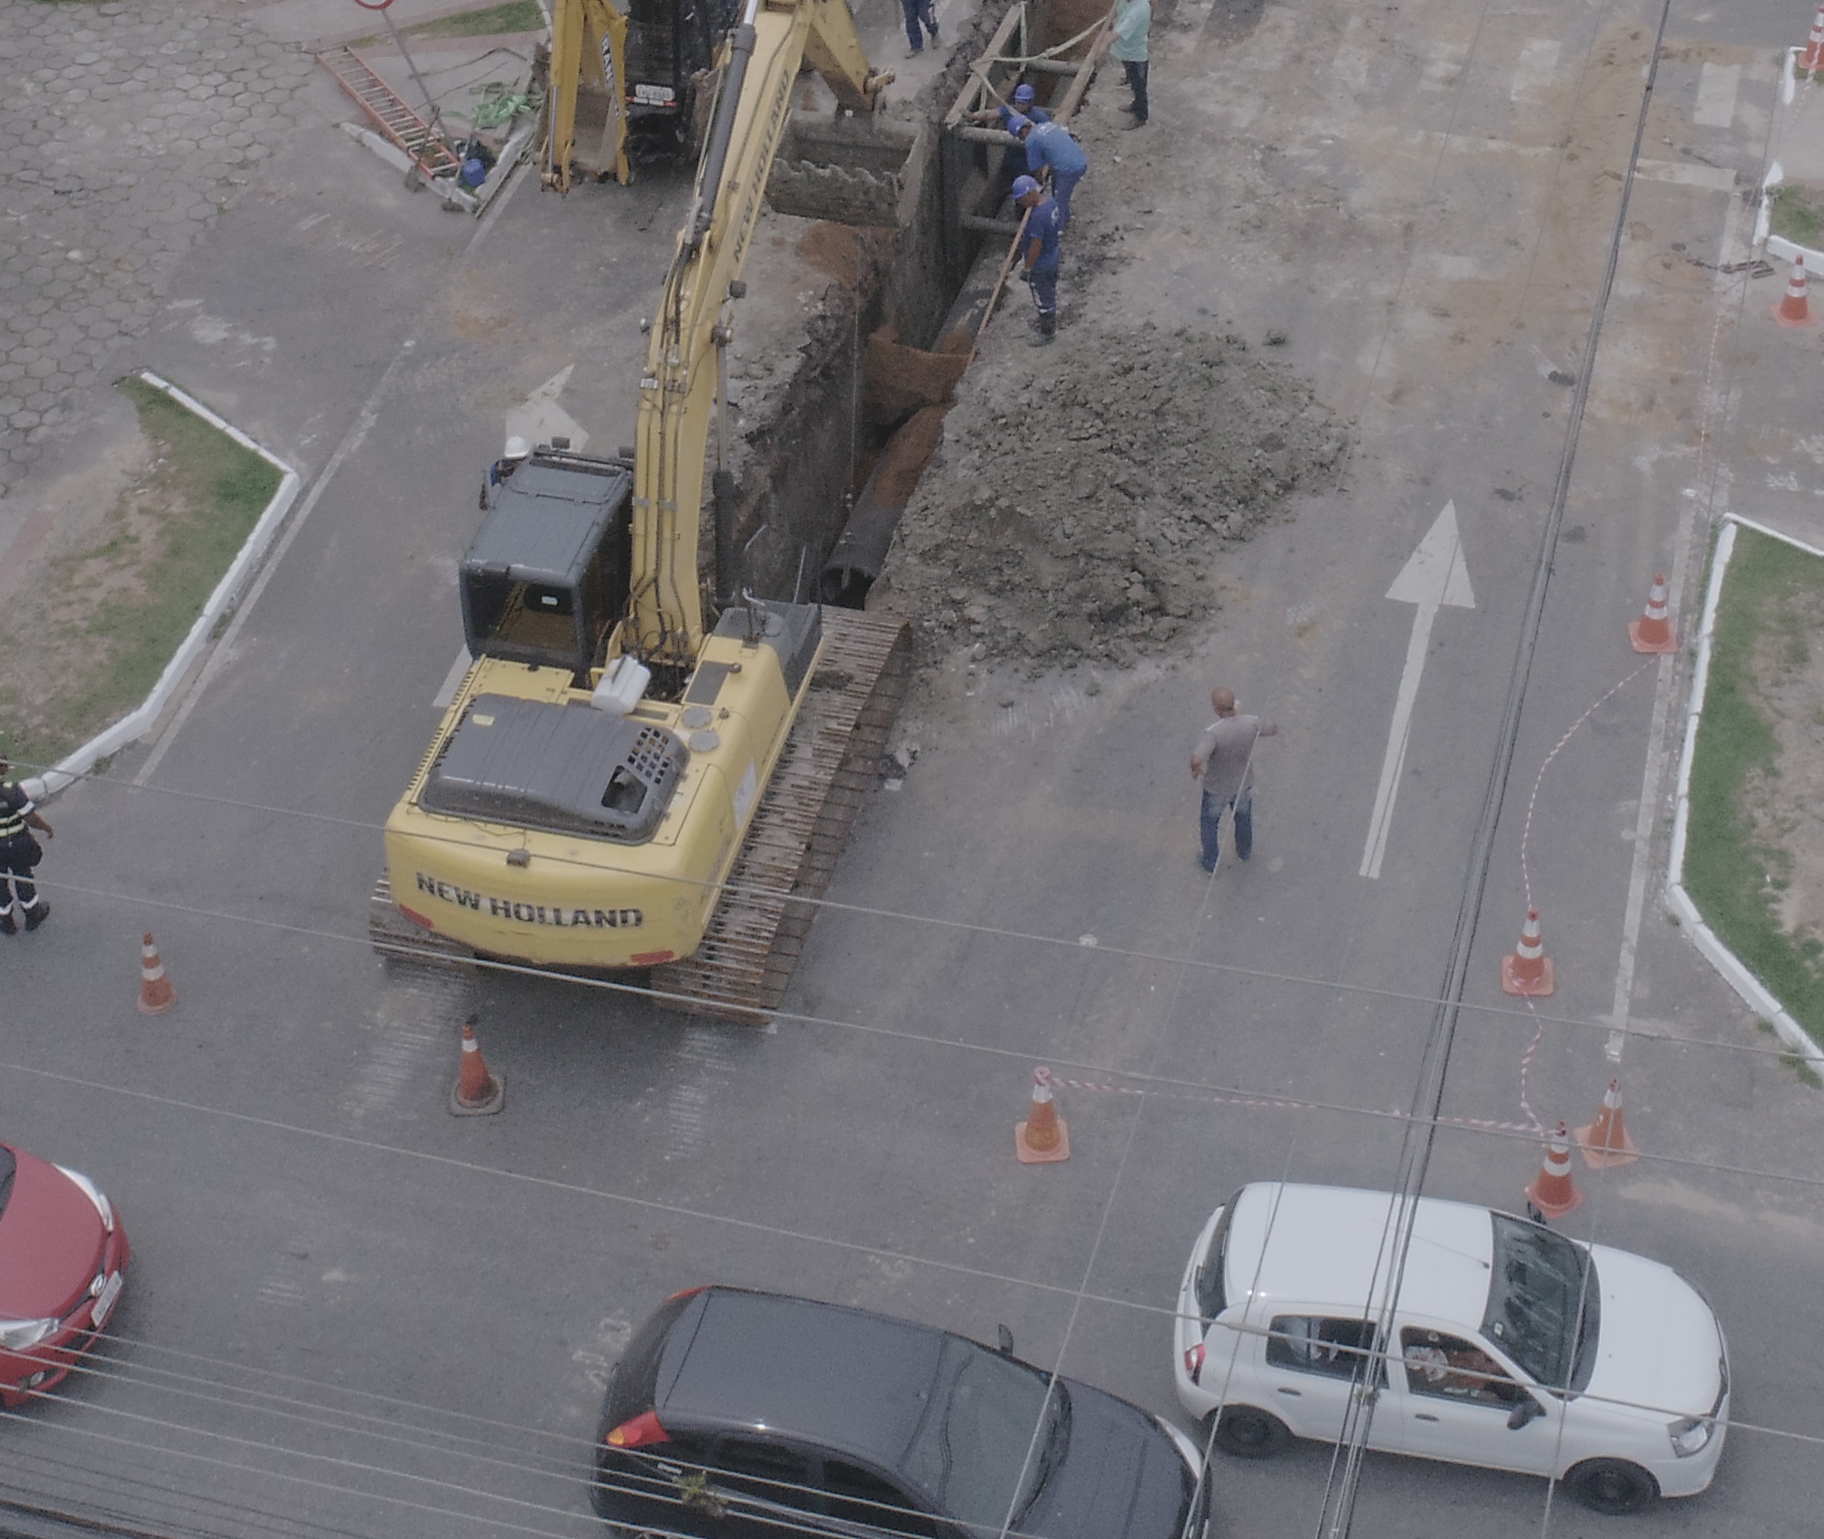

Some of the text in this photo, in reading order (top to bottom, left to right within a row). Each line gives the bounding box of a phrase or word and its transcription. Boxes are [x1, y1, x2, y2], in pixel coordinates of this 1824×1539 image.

[752, 68, 789, 195] HOLLAND
[415, 871, 644, 929] NEW HOLLAND
